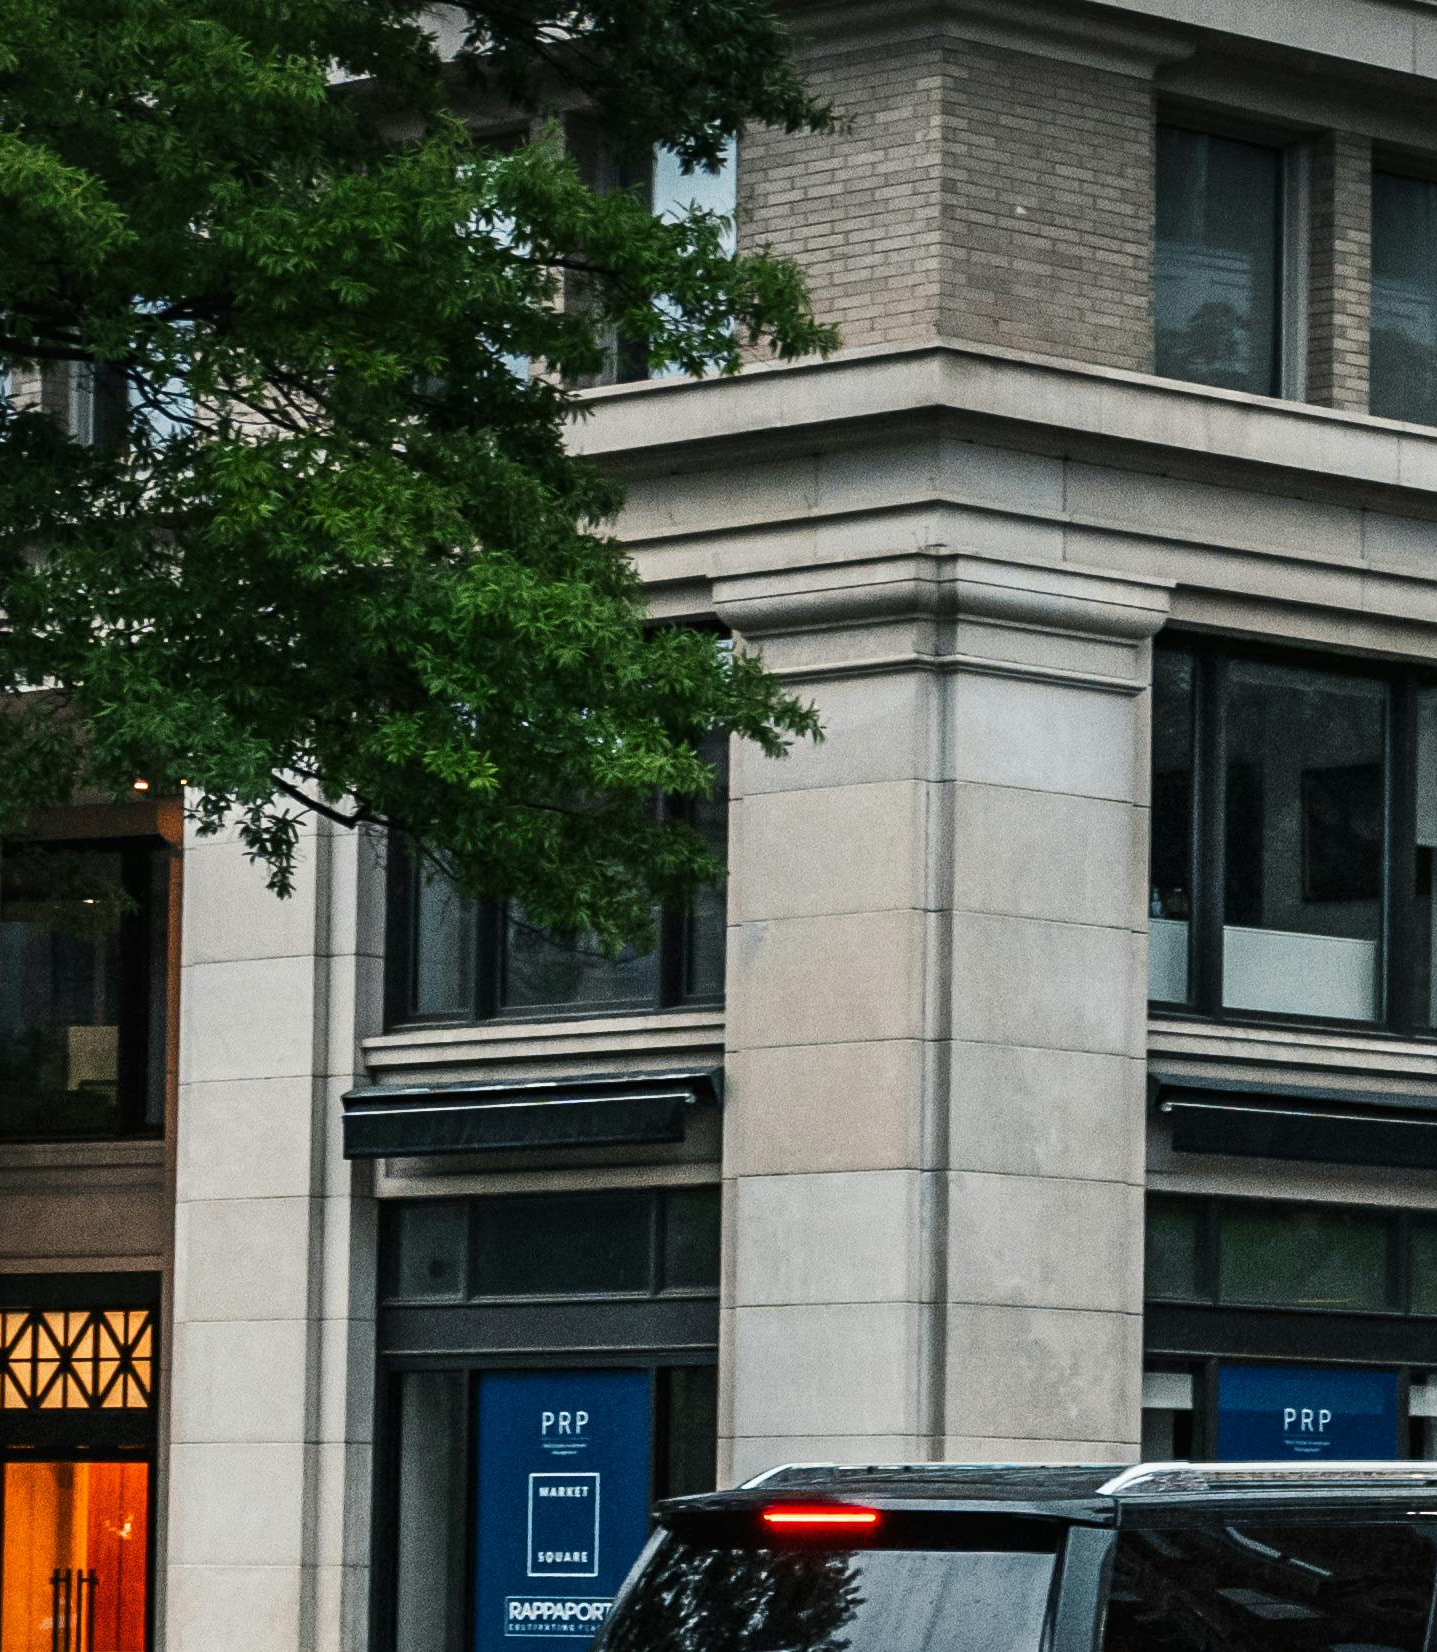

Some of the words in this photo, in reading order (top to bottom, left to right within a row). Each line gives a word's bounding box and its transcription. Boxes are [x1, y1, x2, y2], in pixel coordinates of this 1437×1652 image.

[541, 1411, 589, 1435] PRP
[1283, 1407, 1332, 1432] PRP
[539, 1486, 589, 1498] MARKET
[537, 1551, 588, 1563] SQUARE
[508, 1601, 613, 1621] RAPPAPORT
